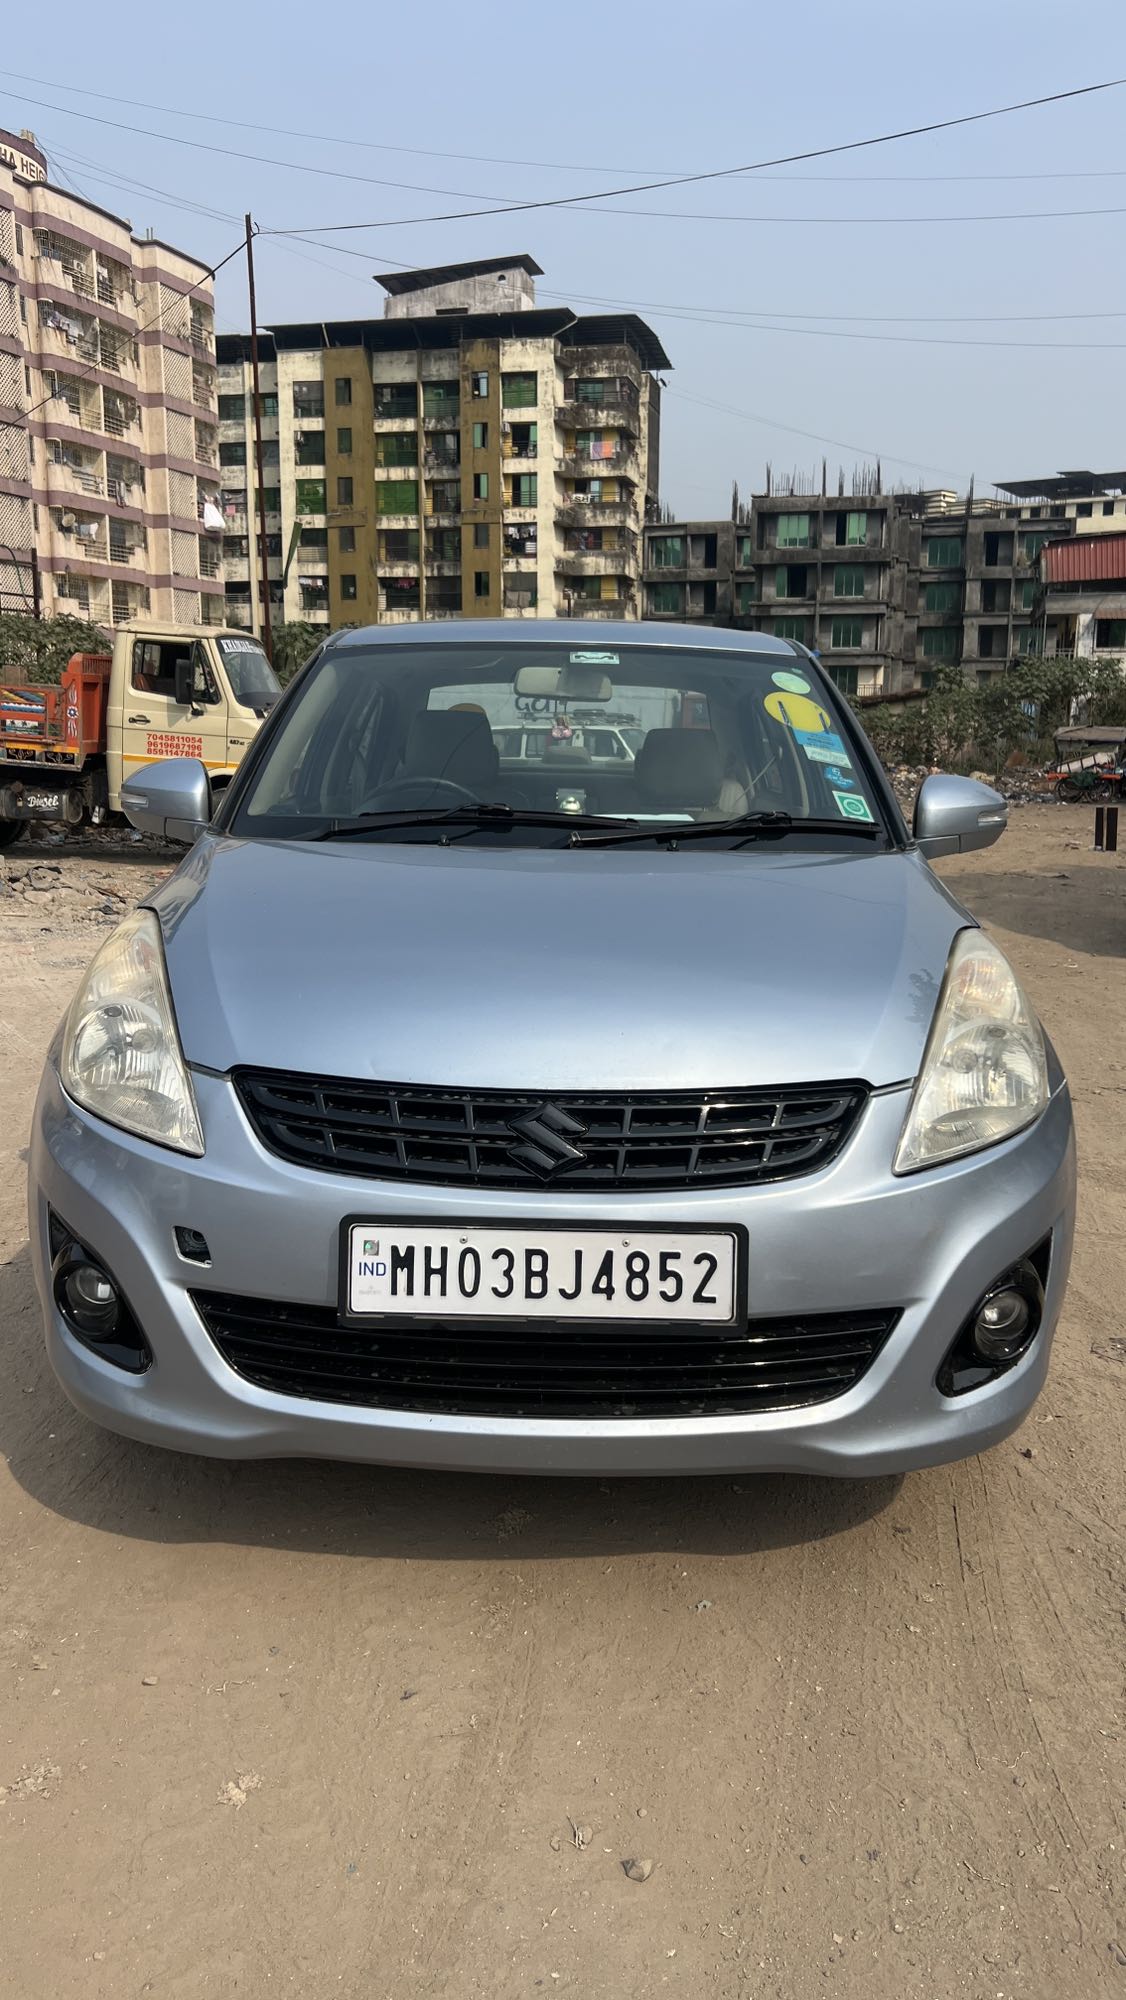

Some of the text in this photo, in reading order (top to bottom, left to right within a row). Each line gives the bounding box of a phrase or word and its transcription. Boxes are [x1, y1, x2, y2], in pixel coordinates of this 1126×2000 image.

[146, 733, 203, 744] 7045811054
[147, 741, 203, 752] 9619687196
[146, 747, 203, 759] 8591147864
[358, 1244, 719, 1305] IND MH03BJ4852
